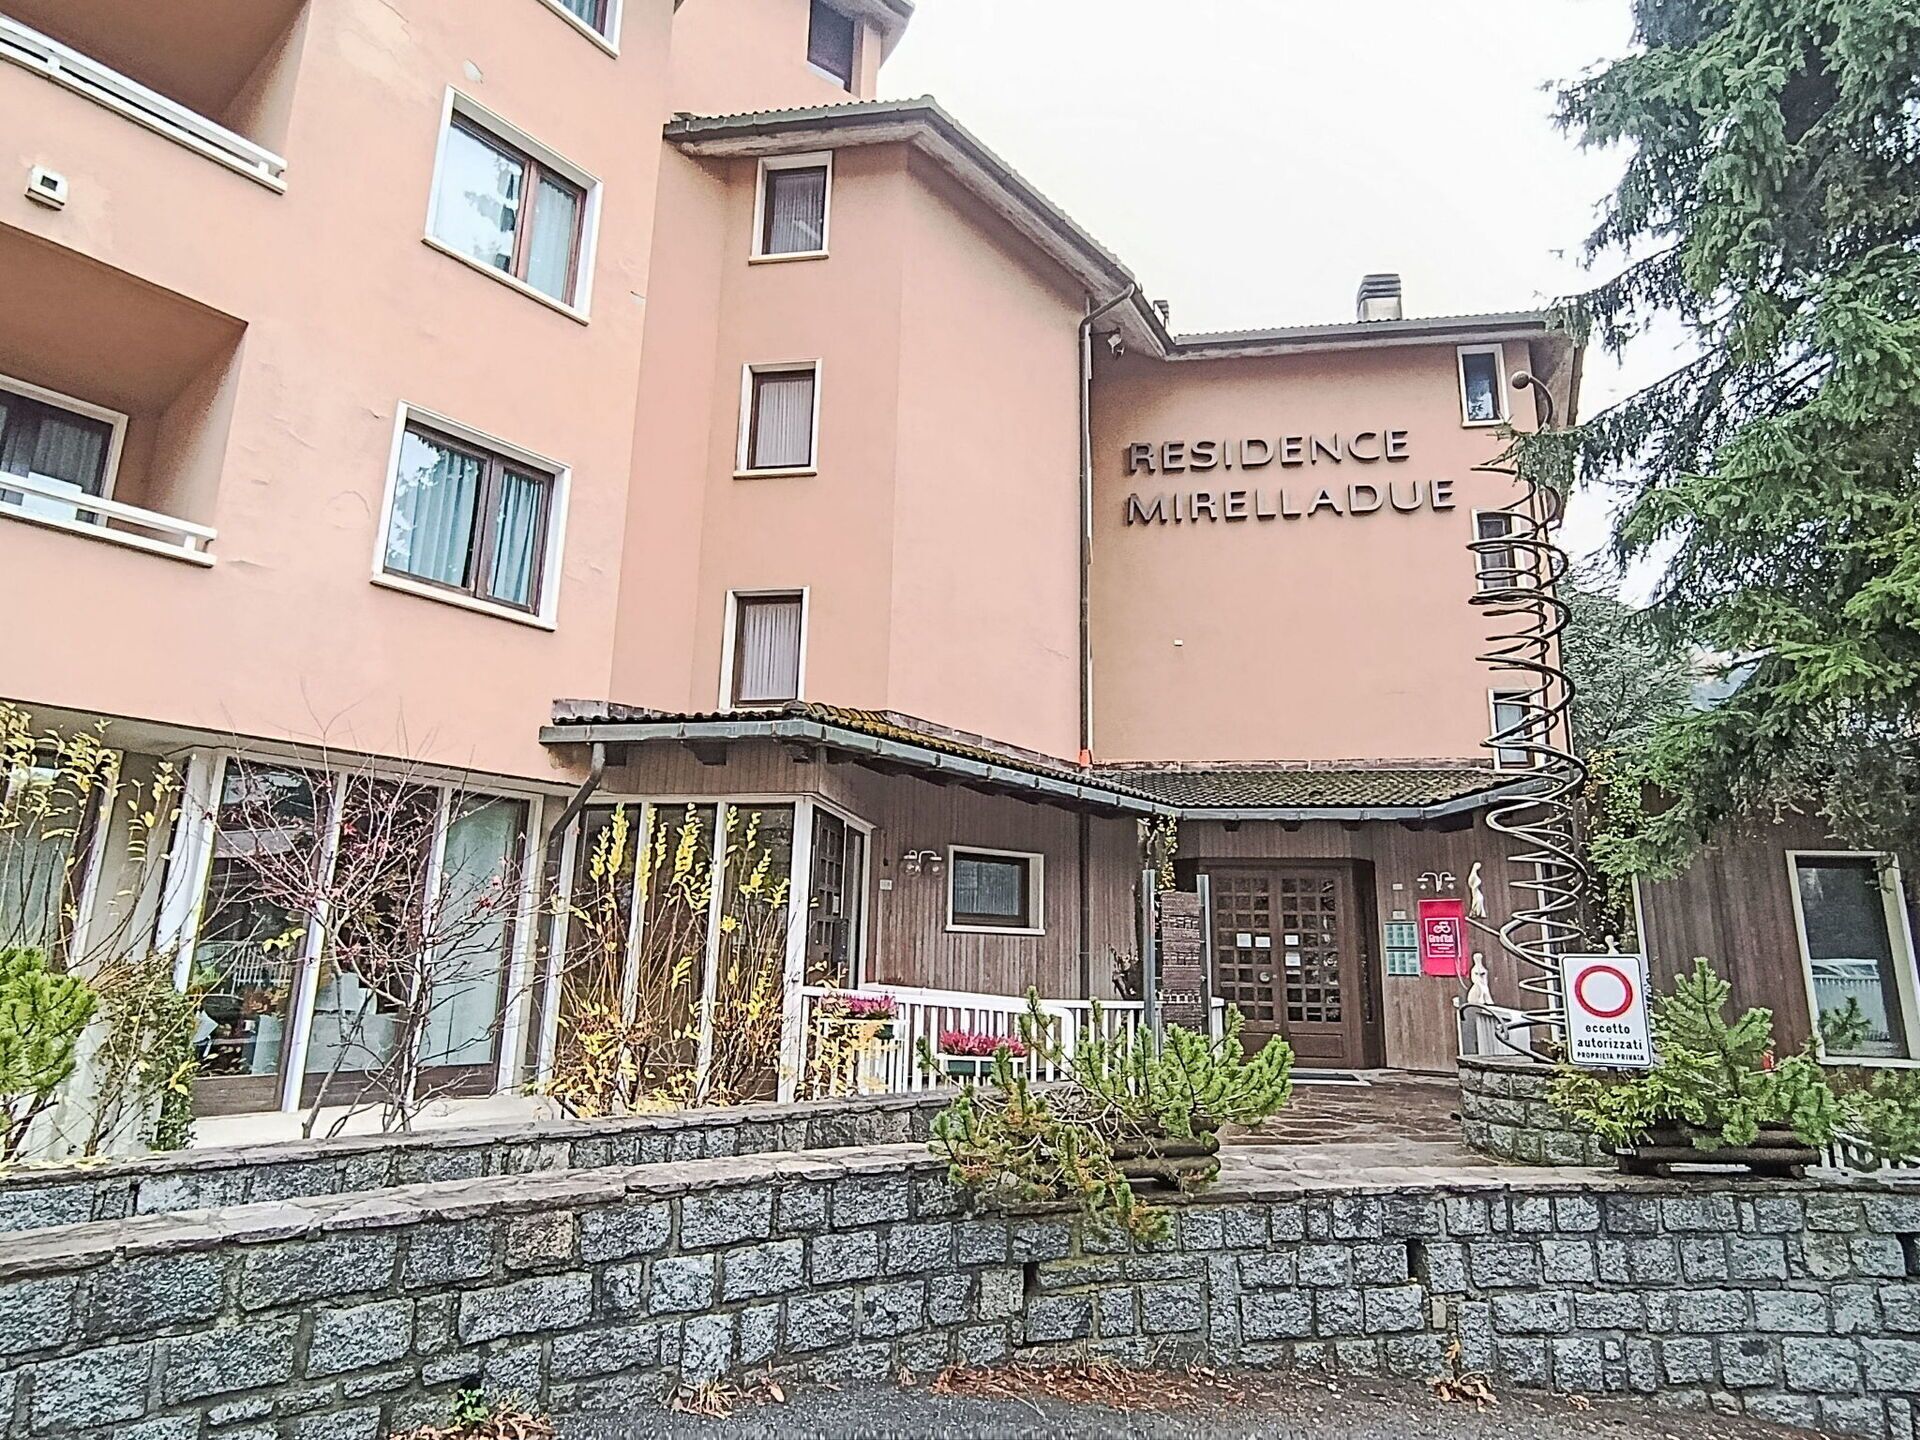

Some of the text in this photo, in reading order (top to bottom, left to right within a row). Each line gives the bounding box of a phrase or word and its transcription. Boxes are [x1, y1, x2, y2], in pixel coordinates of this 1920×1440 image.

[1127, 430, 1410, 473] RESIDENCE
[1126, 480, 1456, 525] MIRELLADUE
[1585, 1023, 1630, 1034] eccetto
[1577, 1037, 1643, 1050] autorizzati
[1616, 1053, 1645, 1061] PRIVATA
